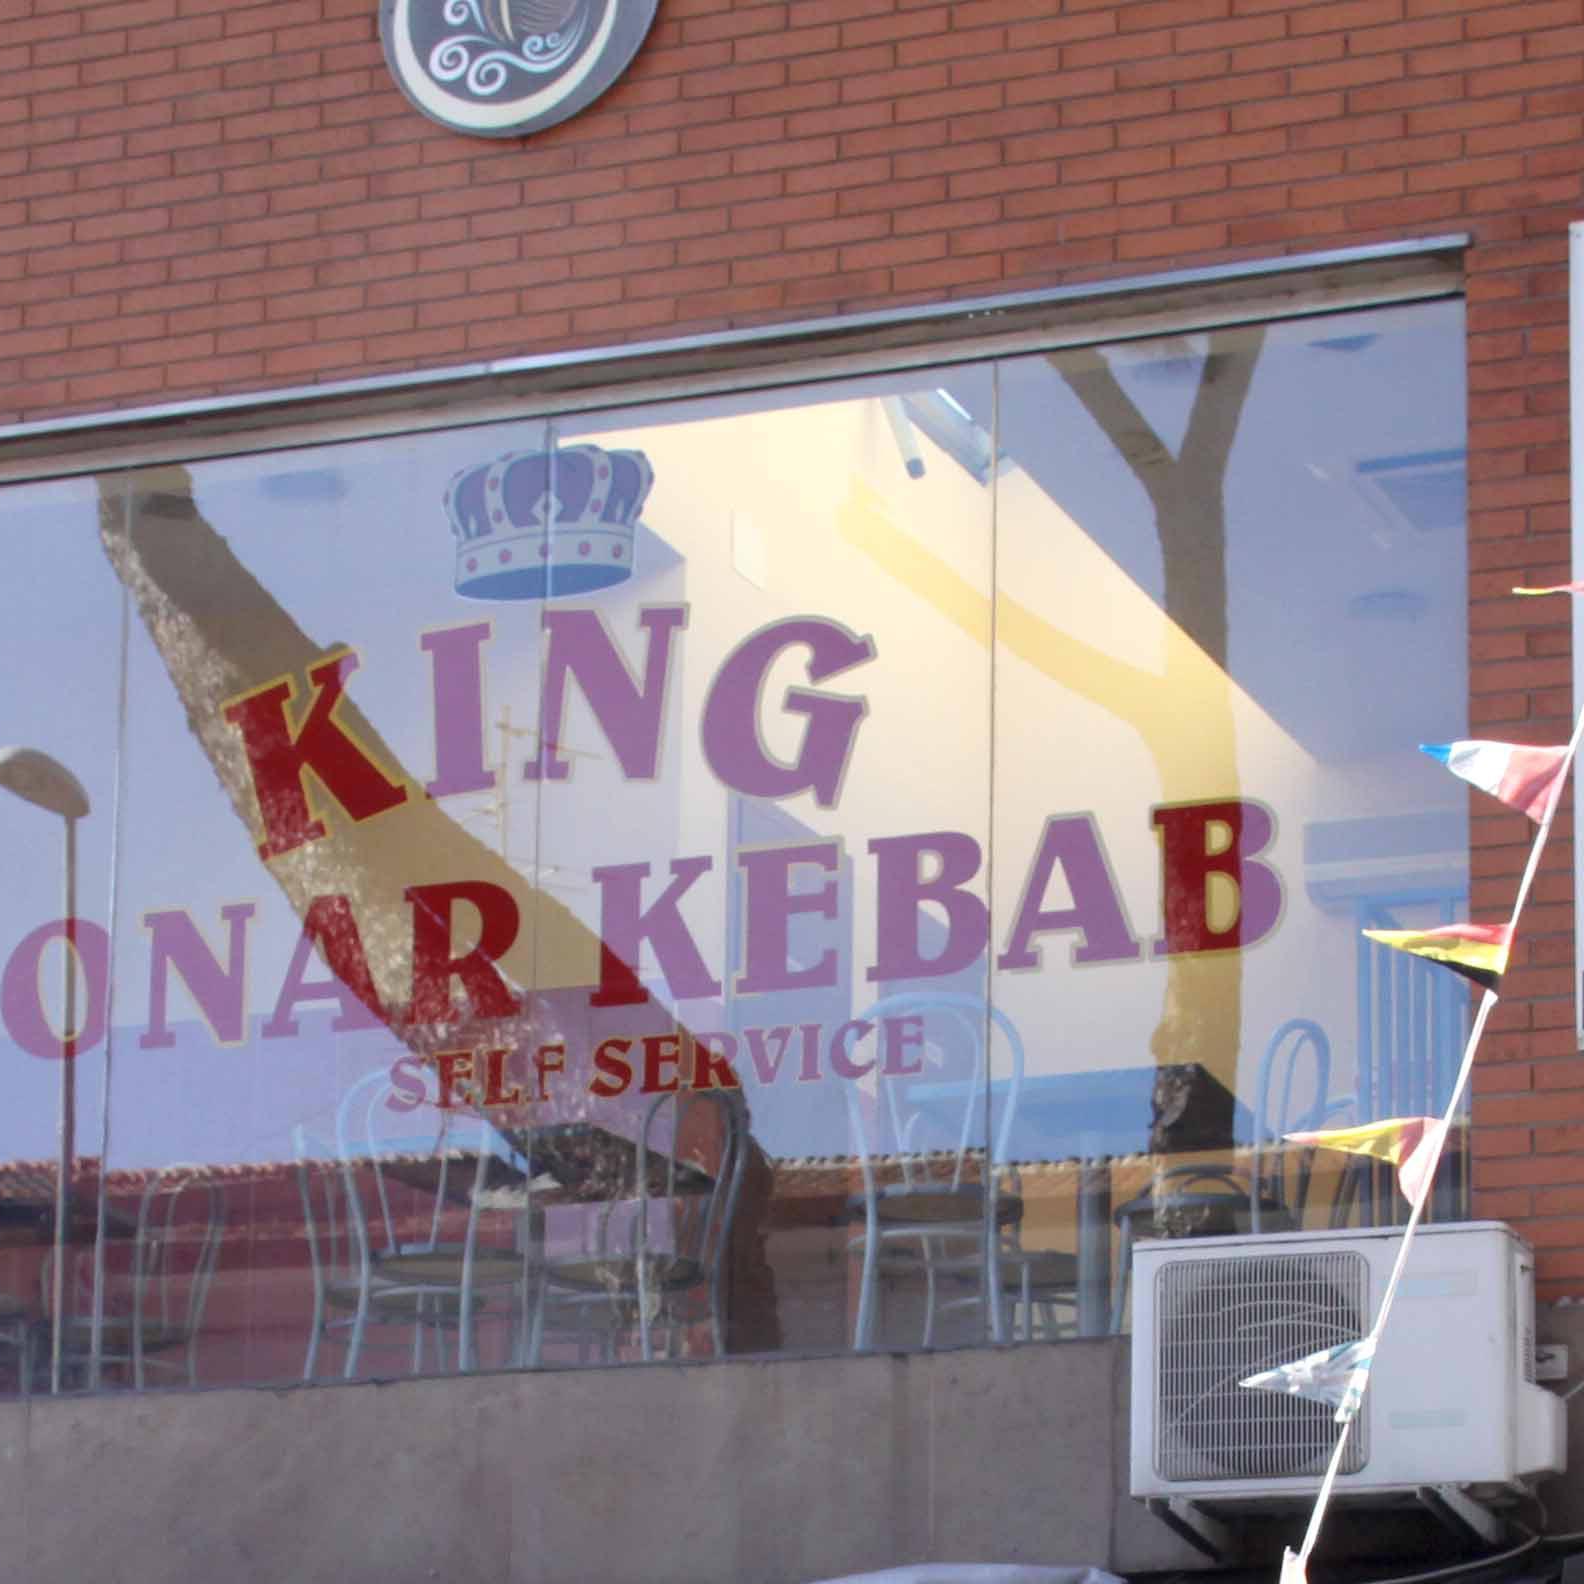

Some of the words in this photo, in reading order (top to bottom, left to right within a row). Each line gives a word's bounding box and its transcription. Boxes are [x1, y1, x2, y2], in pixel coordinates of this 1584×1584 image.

[221, 601, 879, 861] KING
[587, 796, 1286, 1009] KEBAB
[384, 1043, 566, 1113] SELF
[588, 1015, 926, 1098] SERVICE
